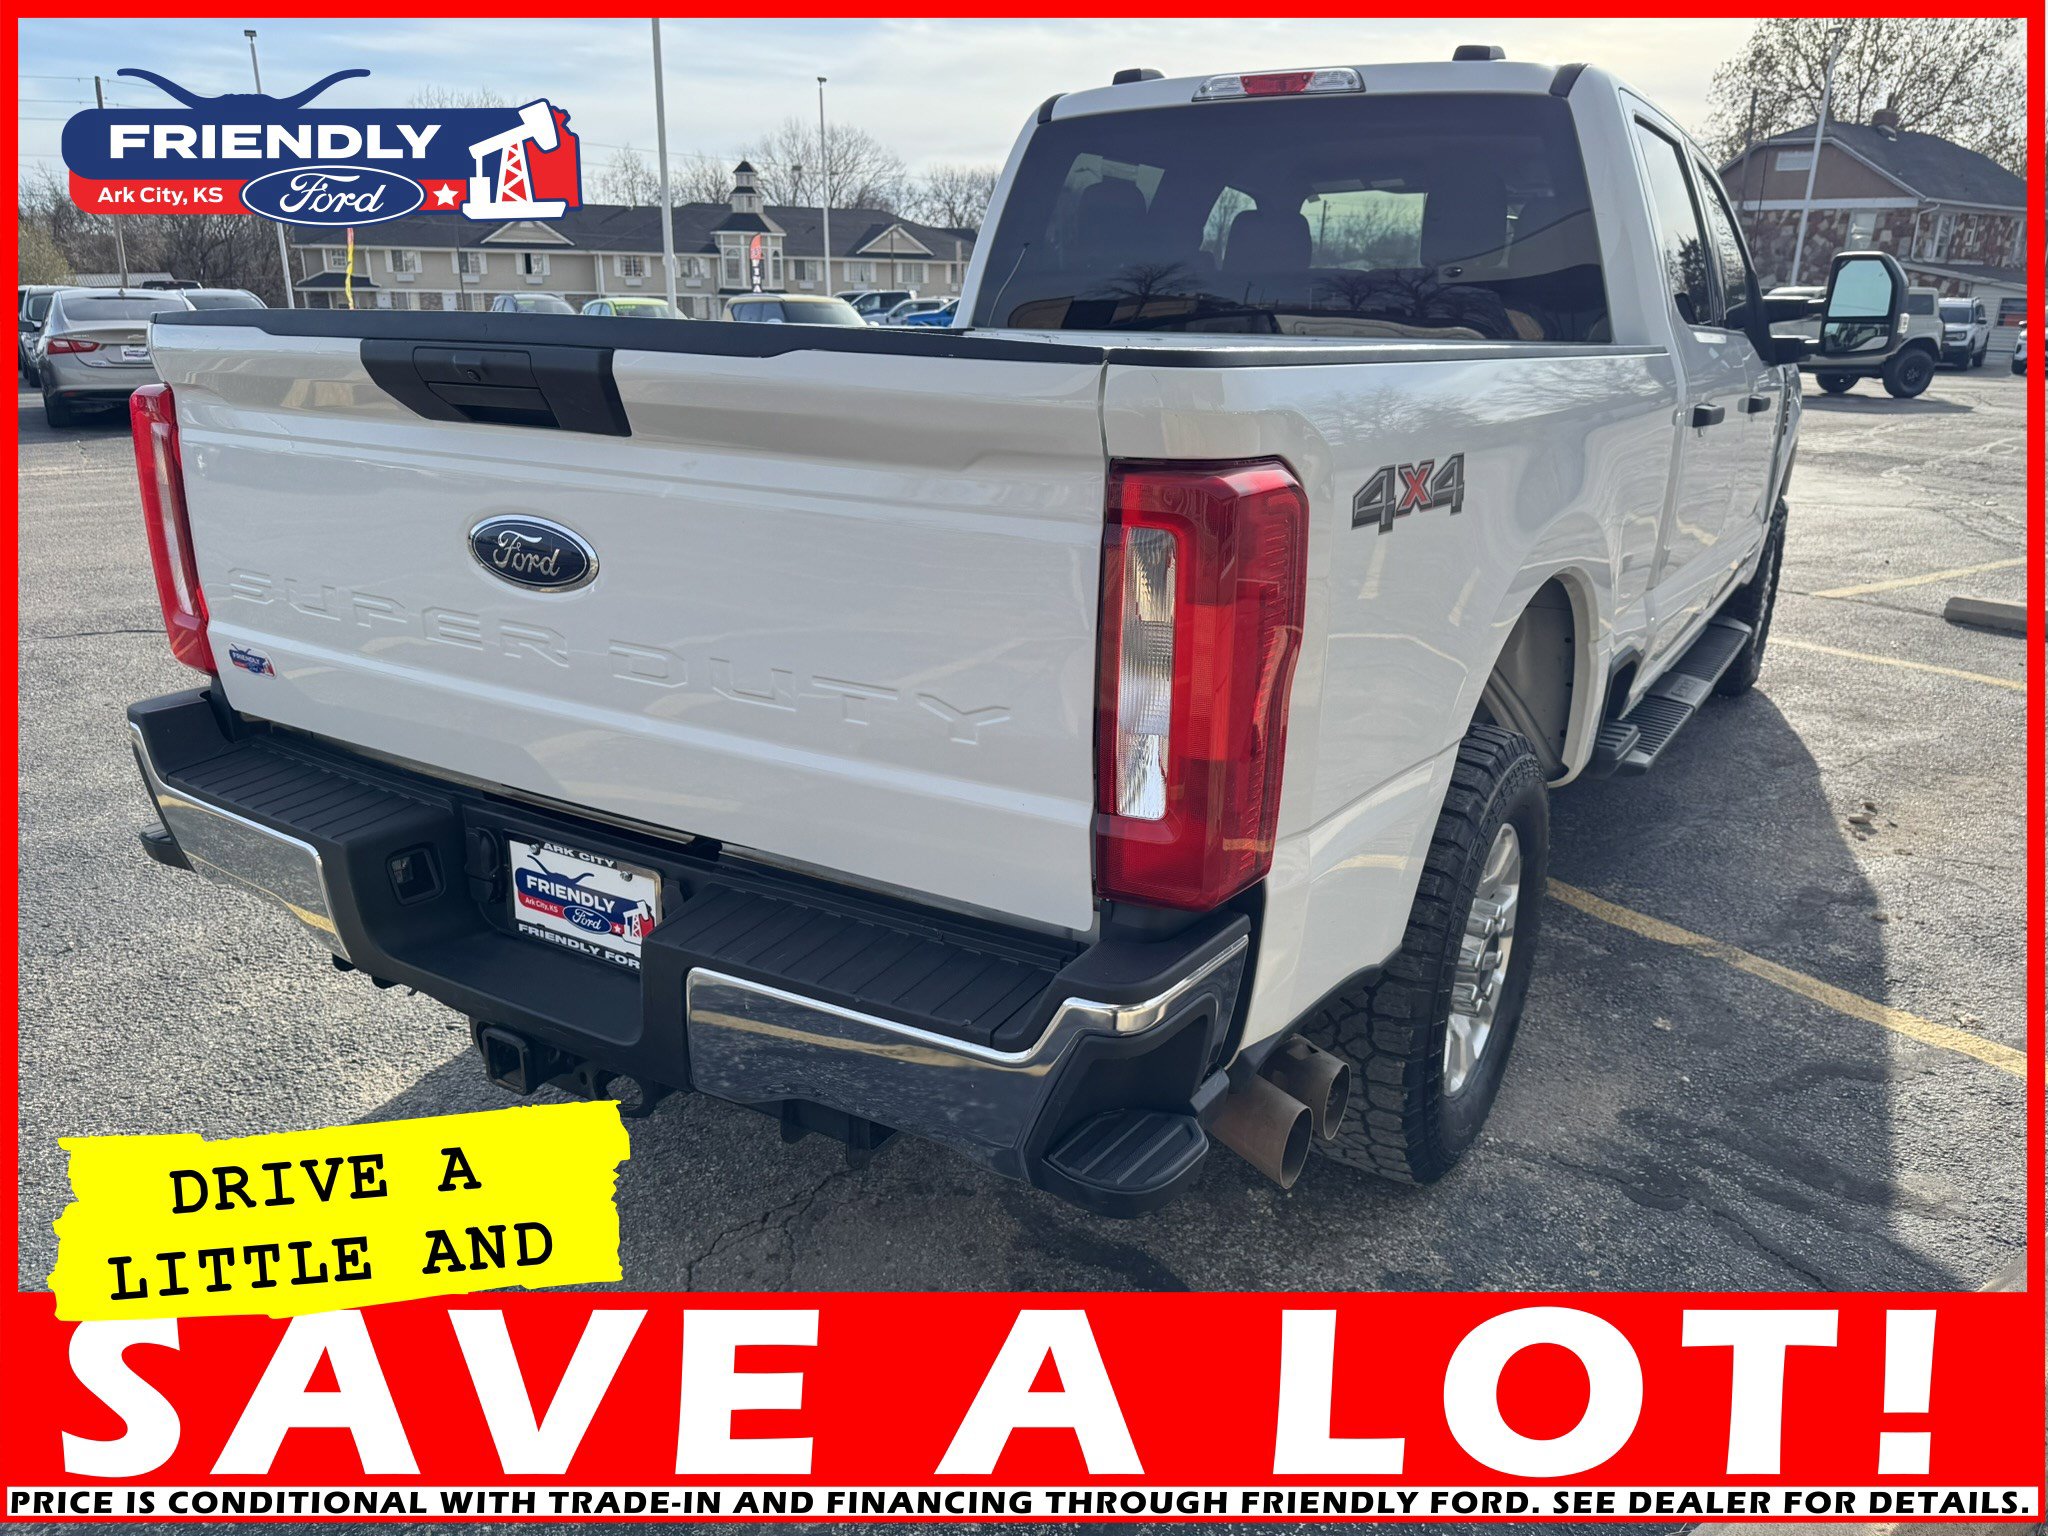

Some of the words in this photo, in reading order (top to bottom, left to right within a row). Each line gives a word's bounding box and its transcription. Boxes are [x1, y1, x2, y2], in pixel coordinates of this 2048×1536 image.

[493, 530, 560, 576] Ford
[228, 567, 570, 668] SUPER
[608, 639, 1011, 745] DUTY
[543, 843, 575, 857] ARK
[579, 852, 617, 868] CITY
[525, 897, 537, 907] Ark
[526, 875, 616, 913] FRIENDLY
[572, 908, 602, 930] Ford
[518, 923, 600, 955] FRIENDLY
[605, 950, 640, 970] FOR
